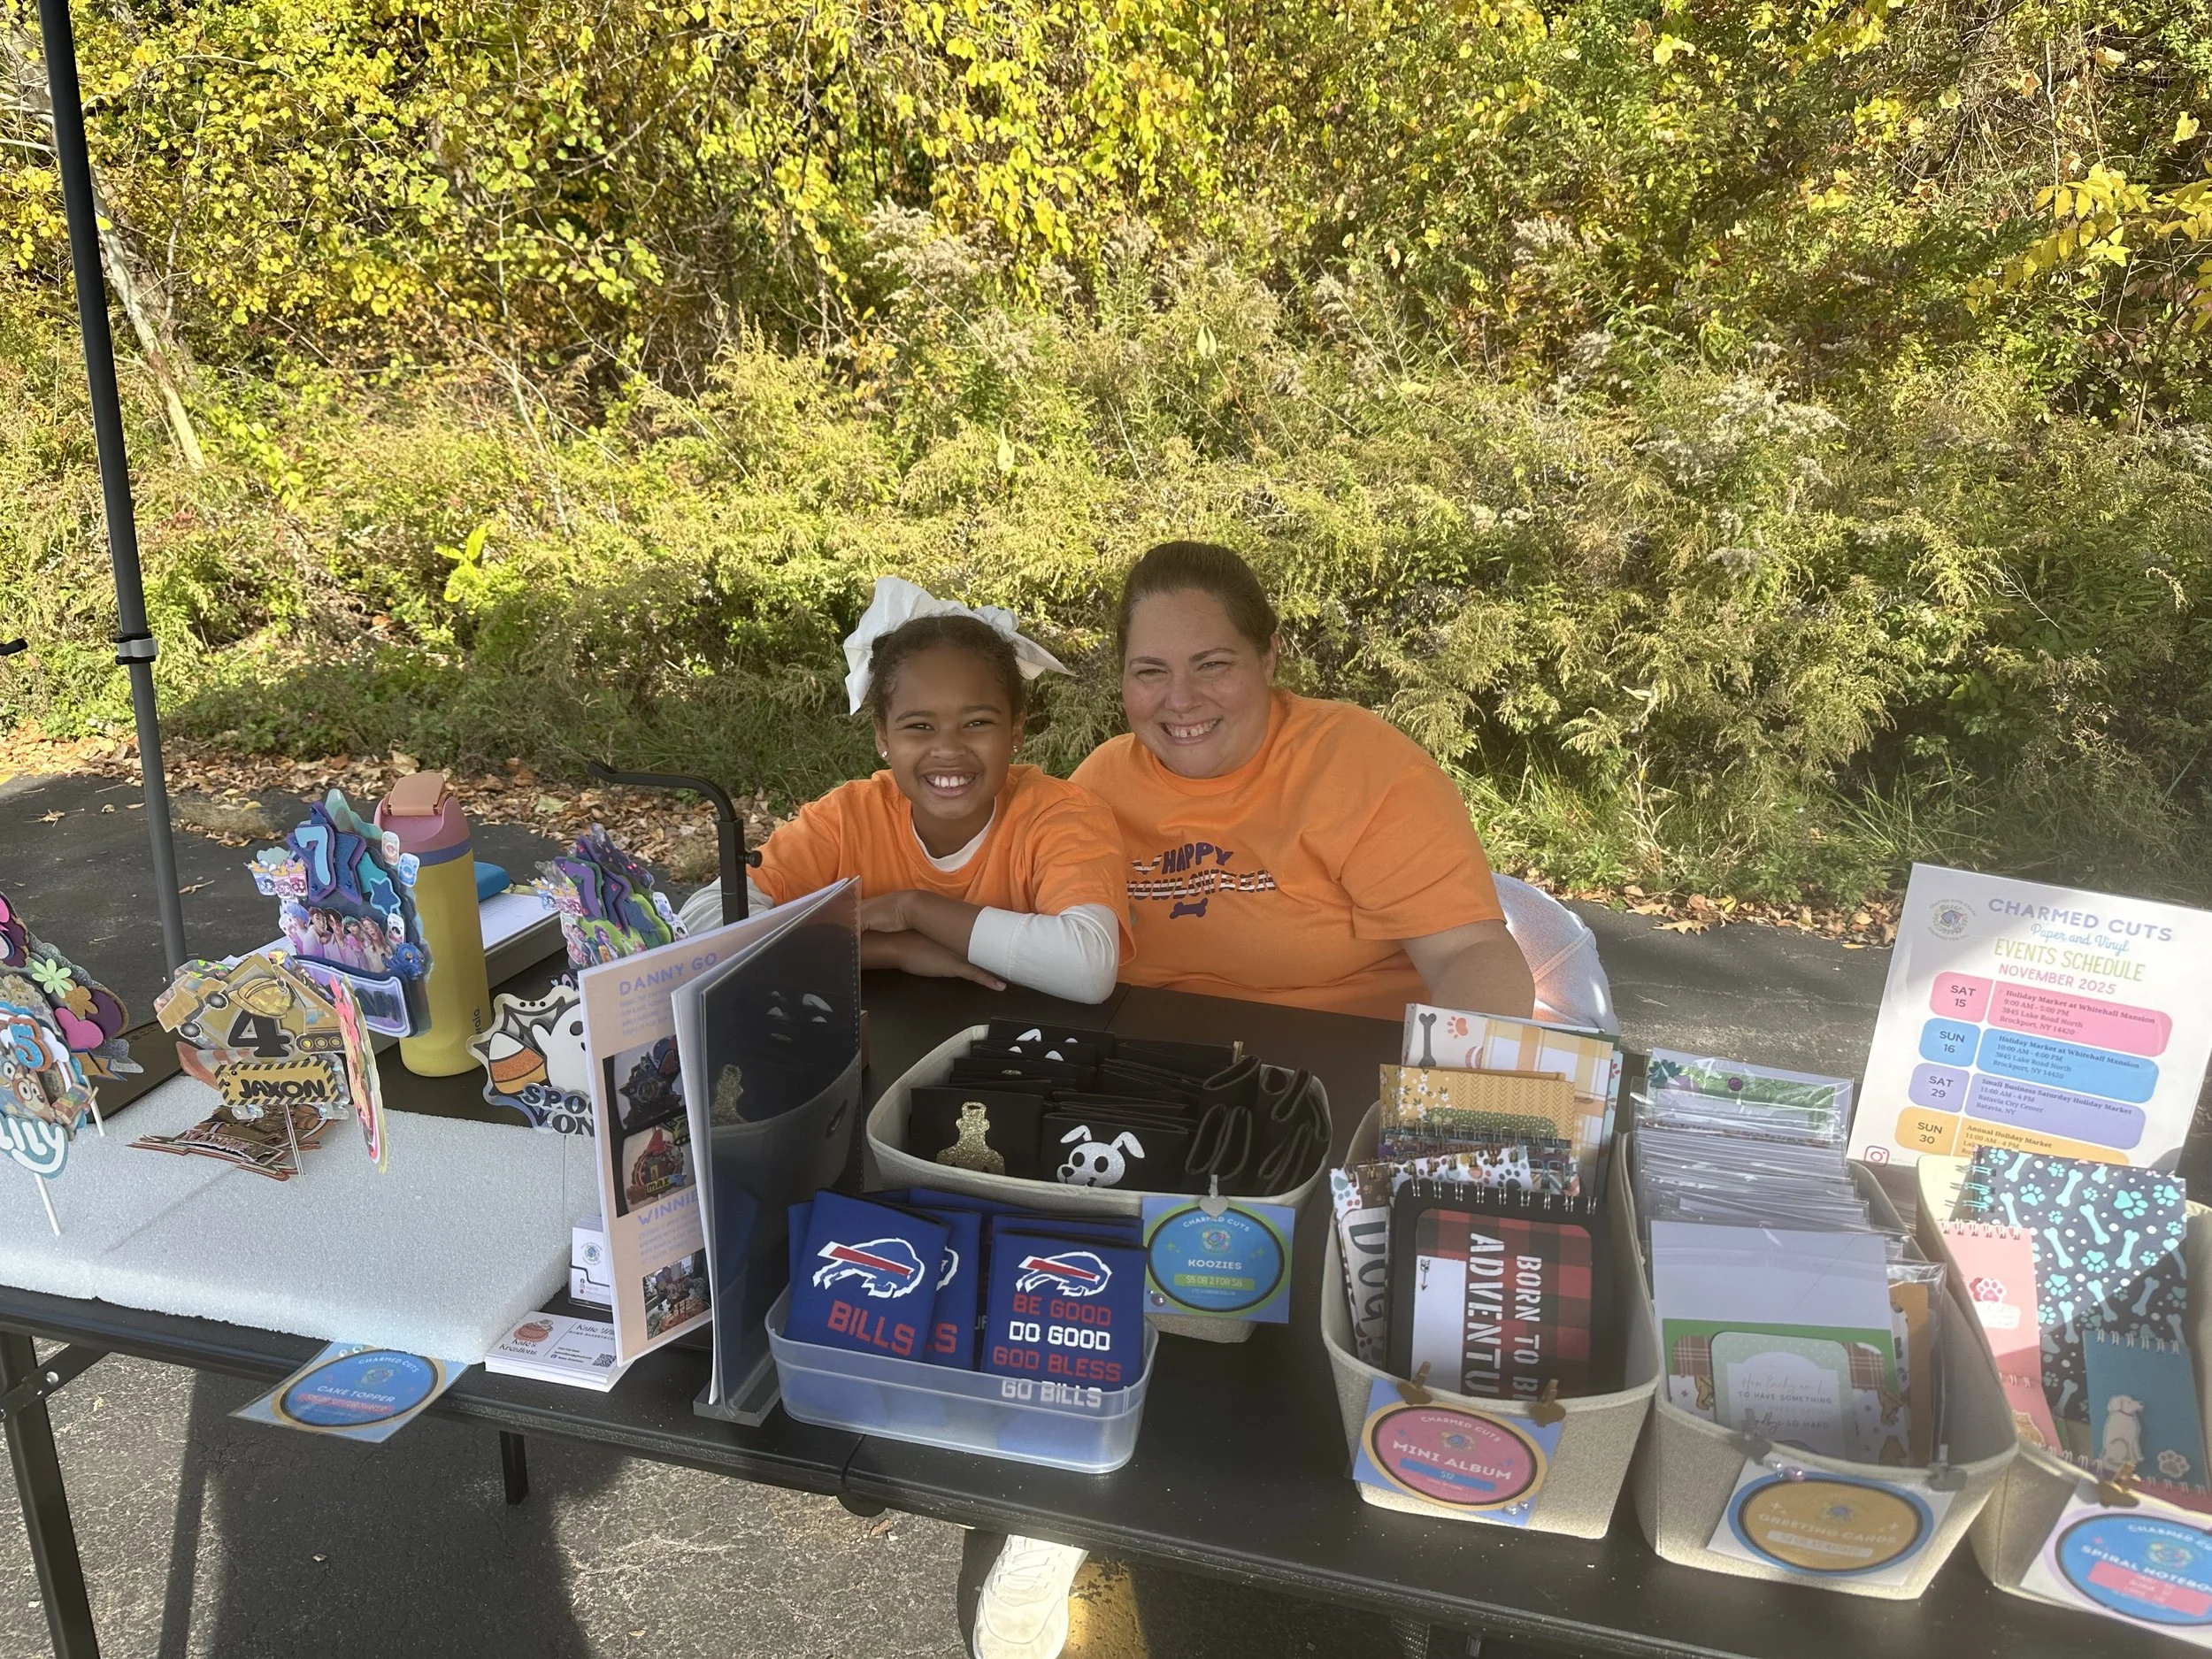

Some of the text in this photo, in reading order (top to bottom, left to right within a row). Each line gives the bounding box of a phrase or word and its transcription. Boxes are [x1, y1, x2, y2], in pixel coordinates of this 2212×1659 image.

[295, 826, 330, 885] 7
[1162, 842, 1233, 874] HAPPY
[1989, 898, 2099, 928] CHARMED
[2108, 919, 2172, 941] CUTS
[2031, 924, 2129, 956] Paper and Vinyl
[1994, 938, 2146, 981] EVENTS SCHEDULE
[618, 952, 718, 995] DANNY GO
[1999, 963, 2116, 995] NOVEMBER 2025
[1950, 985, 1976, 996] SAT
[1955, 998, 1967, 1008] 15
[2006, 990, 2037, 1002] Holiday
[2039, 996, 2068, 1007] Market
[2078, 1003, 2118, 1017] Whitehall
[2120, 1012, 2155, 1024] Mansion
[2020, 1010, 2039, 1019] Lake
[9, 1021, 48, 1071] 5
[227, 1009, 293, 1058] 4
[1939, 1031, 1964, 1043] SUN
[1944, 1044, 1955, 1054] 16
[1999, 1035, 2029, 1047] Holiday
[2029, 1041, 2057, 1052] Market
[2068, 1048, 2106, 1063] Whitehall
[2107, 1057, 2139, 1069] Mansion
[2013, 1055, 2030, 1064] Lake
[238, 1079, 326, 1100] JAXON
[1929, 1076, 1954, 1087] SAT
[1931, 1088, 1946, 1098] 29
[1999, 1089, 2012, 1098] AM
[524, 1086, 593, 1115] SPO
[1982, 1079, 2132, 1115] Small Business Saturday Holiday Market
[1917, 1122, 1943, 1134] SUN
[1919, 1134, 1935, 1144] 30
[1967, 1125, 2052, 1148] Annual Holiday Market
[1985, 1136, 1997, 1145] AM
[1227, 1218, 1250, 1233] CUTS
[1187, 1259, 1242, 1271] KOOZIES
[1197, 1275, 1208, 1285] OR
[1216, 1277, 1230, 1286] FOR
[1514, 1256, 1542, 1322] BORN
[1013, 1294, 1111, 1327] BE GOOD
[827, 1299, 916, 1356] BILLS
[1009, 1321, 1041, 1343] DO
[1047, 1325, 1110, 1351] GOOD
[1513, 1334, 1540, 1364] TO
[358, 1356, 419, 1373] CHARMED CUTS
[993, 1346, 1122, 1382] GOD BLESS
[317, 1385, 396, 1402] CAKE TOPPER
[1001, 1379, 1102, 1409] GO BILLS
[1779, 1394, 1832, 1404] SOMETHING
[1420, 1416, 1502, 1442] CHARMED CUTS
[1393, 1440, 1512, 1480] MINI ALBUM
[1841, 1531, 1897, 1544] CARDS
[2127, 1524, 2194, 1543] CHARMED
[2081, 1545, 2139, 1571] SPIRAL
[2142, 1567, 2212, 1593] NOTEBO
